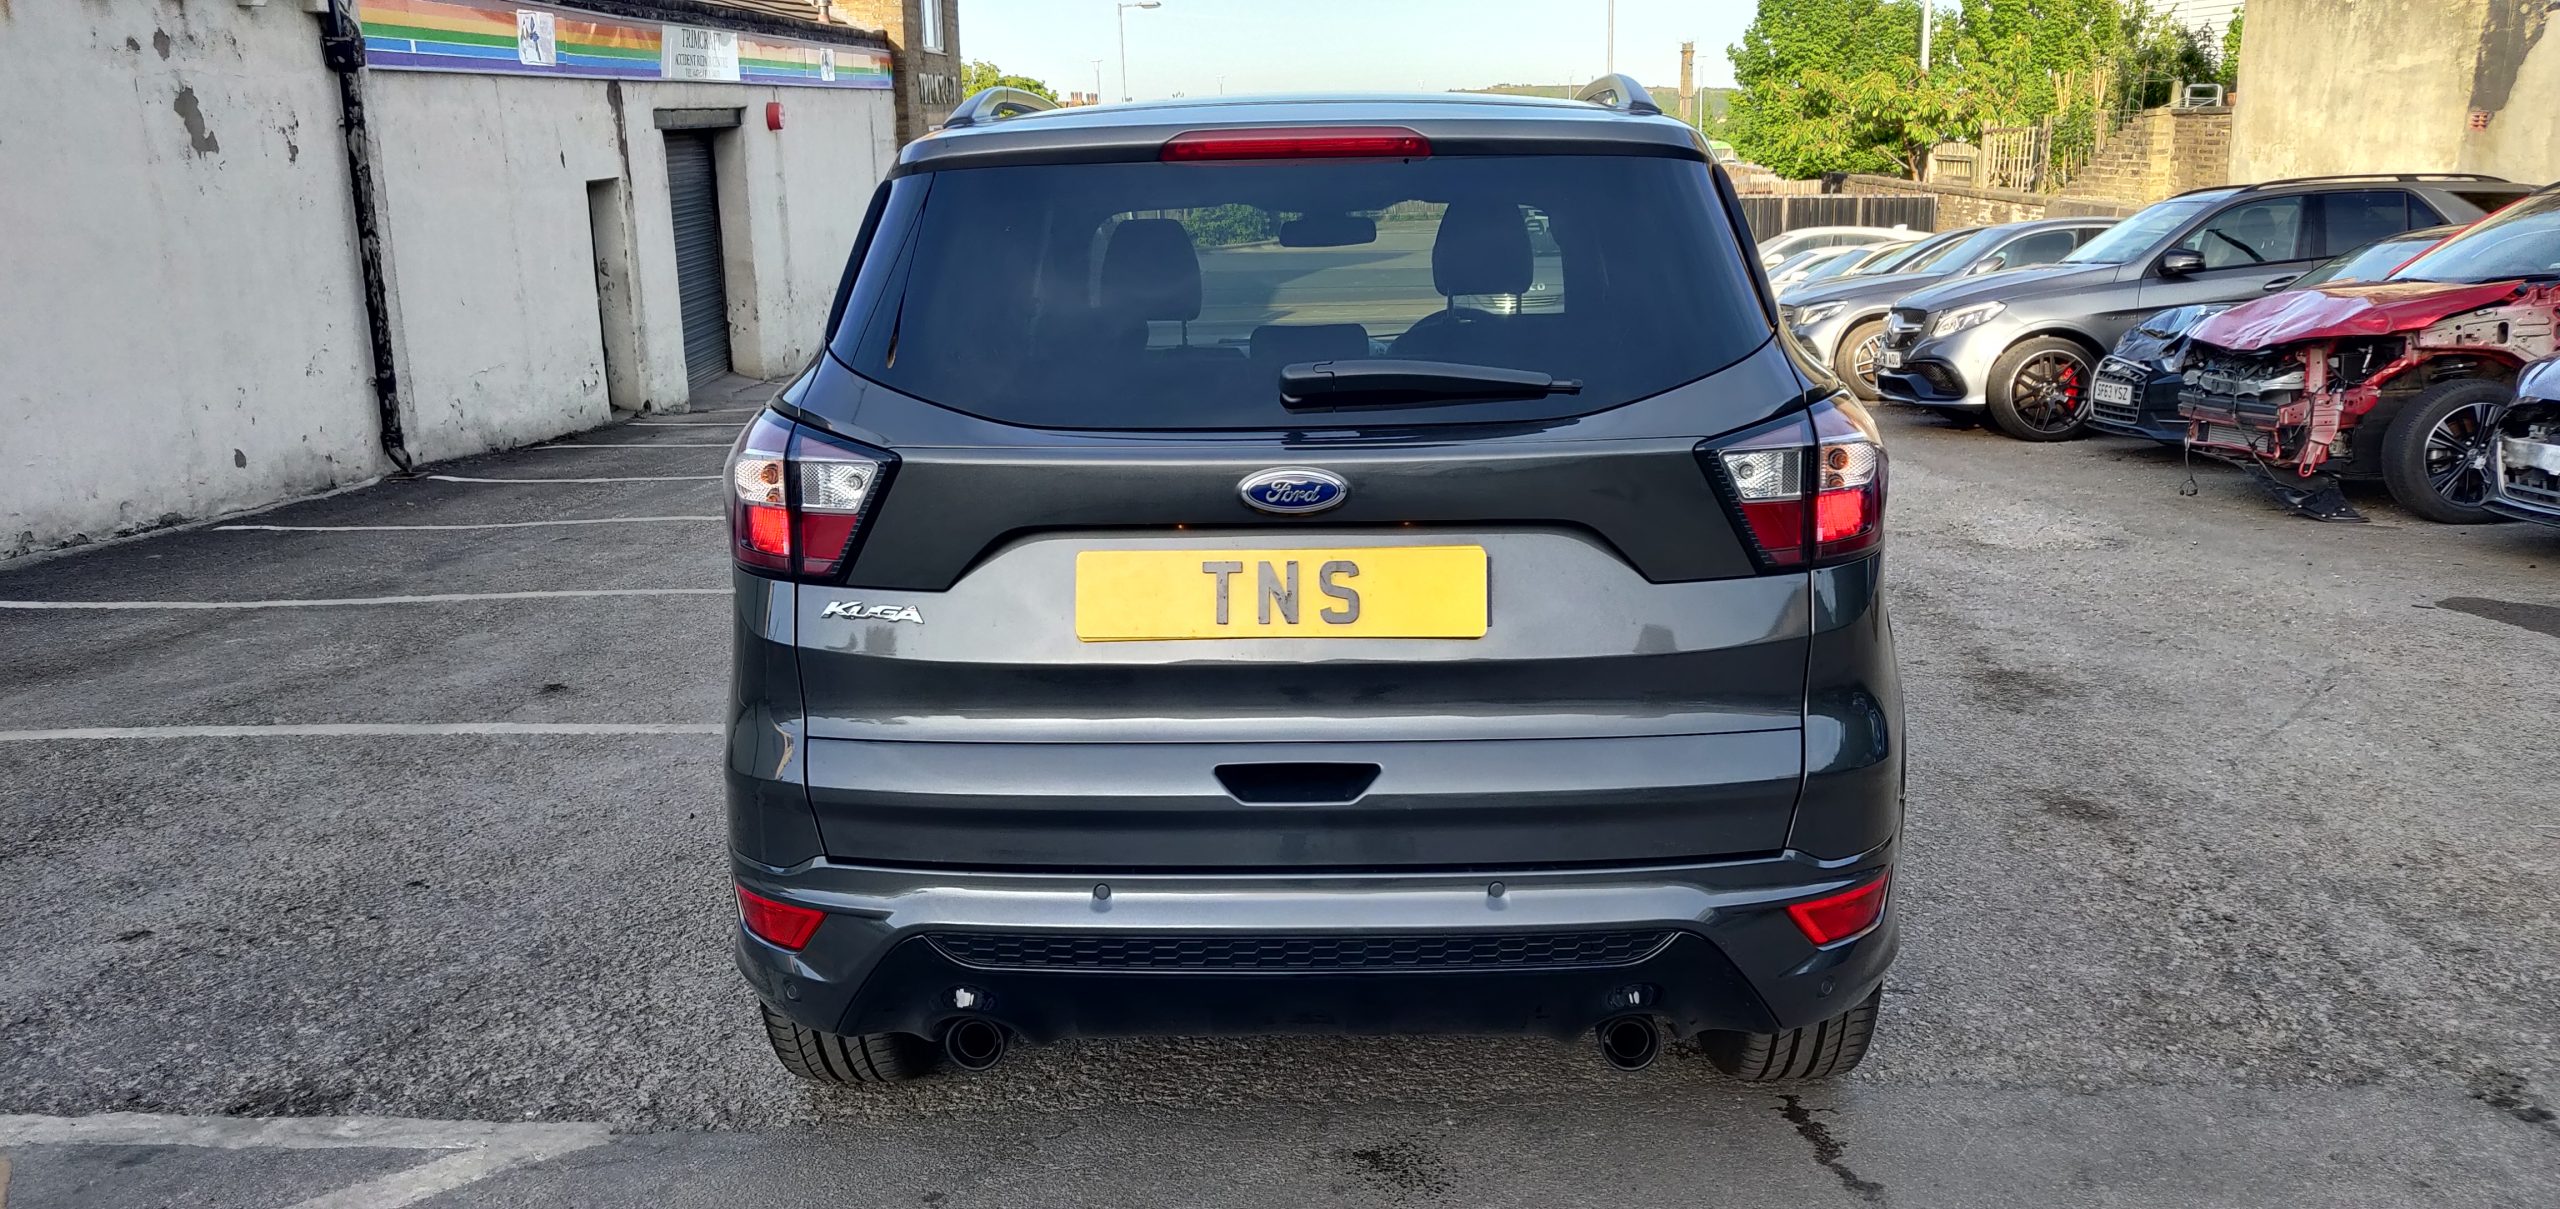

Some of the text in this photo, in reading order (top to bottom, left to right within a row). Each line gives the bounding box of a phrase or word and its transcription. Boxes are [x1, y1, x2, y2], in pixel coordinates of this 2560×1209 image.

[2097, 383, 2128, 401] SF63 YSZ
[1266, 480, 1321, 503] Ford
[1202, 560, 1361, 625] TNS
[820, 601, 925, 624] KUGA
